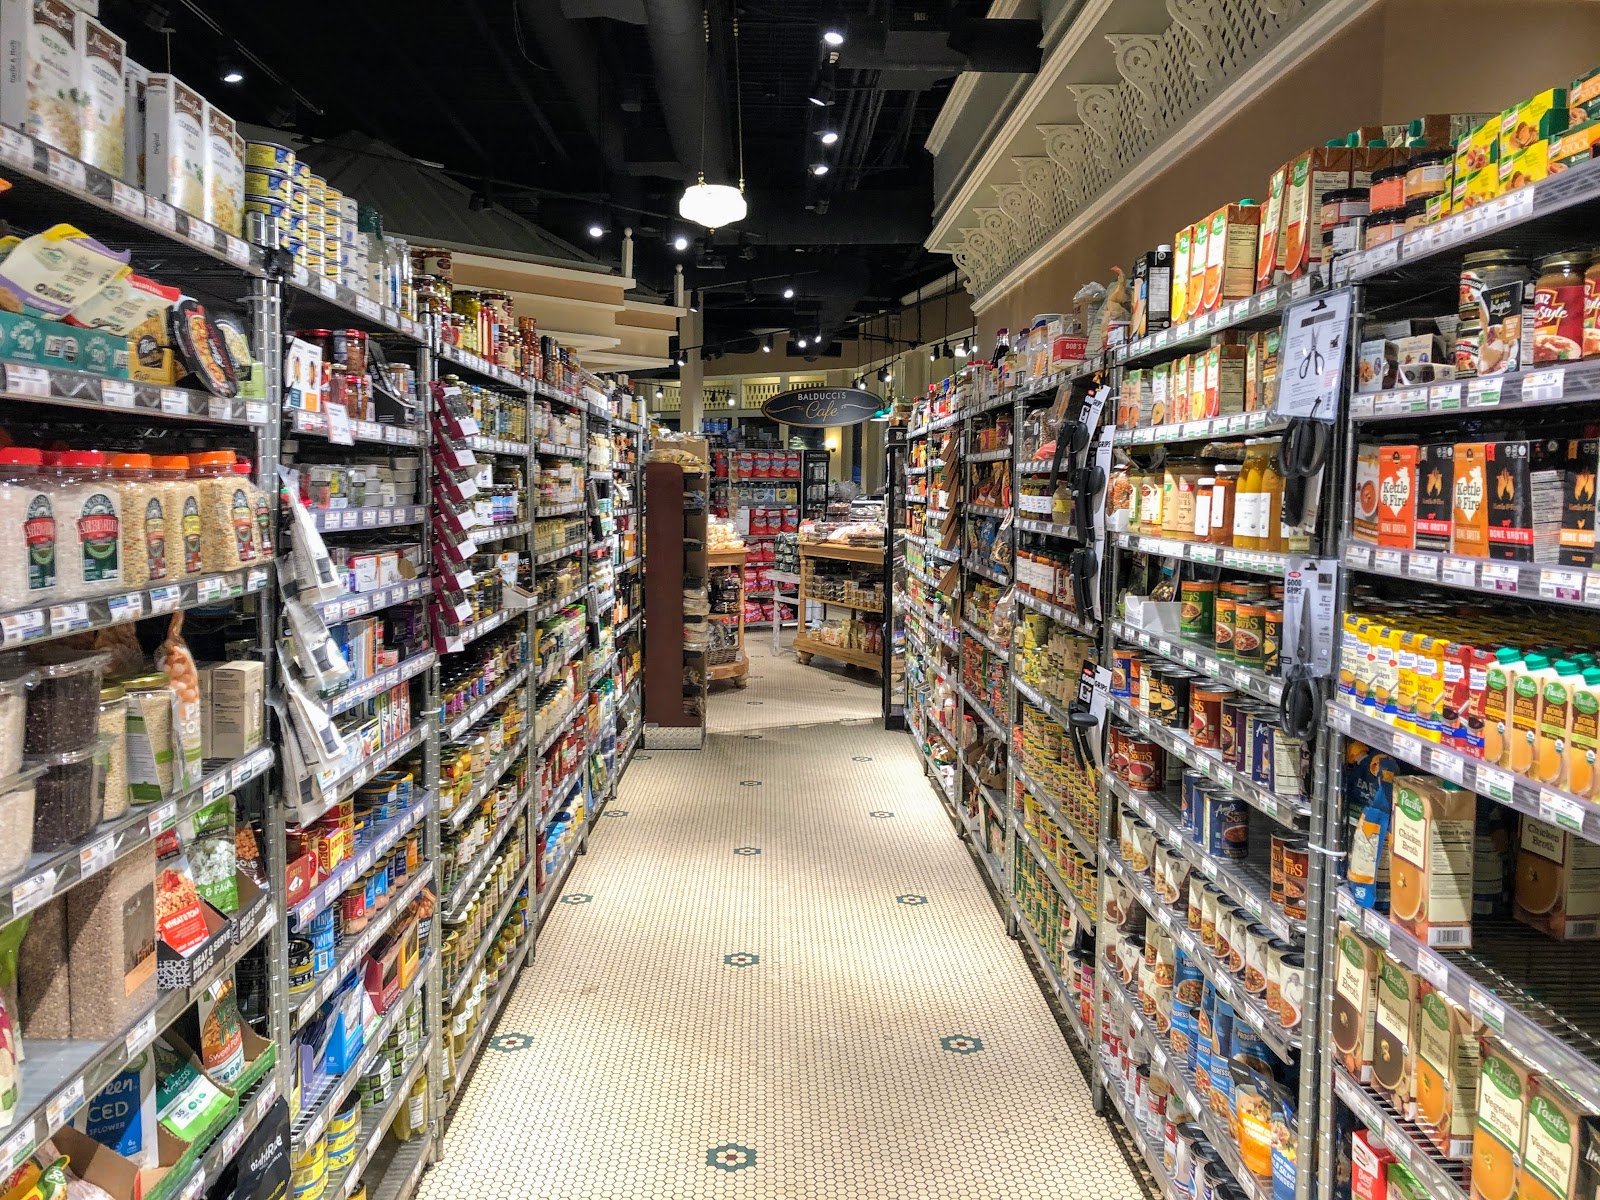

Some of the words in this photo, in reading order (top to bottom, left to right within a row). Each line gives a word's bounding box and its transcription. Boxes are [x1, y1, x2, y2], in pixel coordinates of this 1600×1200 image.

[805, 400, 838, 422] Cafe
[1383, 481, 1408, 494] Kettle
[1456, 482, 1481, 497] Kettle
[1389, 494, 1407, 507] Fire
[1462, 497, 1480, 511] Fire
[1287, 579, 1302, 587] GOOD
[1399, 789, 1423, 813] Pacific
[1398, 827, 1422, 848] Chicken
[1528, 823, 1560, 843] Chicken
[164, 914, 184, 930] WHEAT
[193, 951, 209, 969] HEAT
[213, 929, 231, 953] SERVE
[193, 956, 214, 982] PILAFS
[1345, 967, 1360, 987] Beef
[208, 1043, 229, 1063] Sweet
[1490, 1058, 1519, 1092] Pacific
[1484, 1092, 1519, 1129] Vegetable
[1537, 1097, 1569, 1136] Pacific
[1490, 1111, 1512, 1137] Broth
[1531, 1135, 1568, 1174] Vegetable
[1279, 1164, 1296, 1184] SALMO
[1537, 1154, 1561, 1182] Broth
